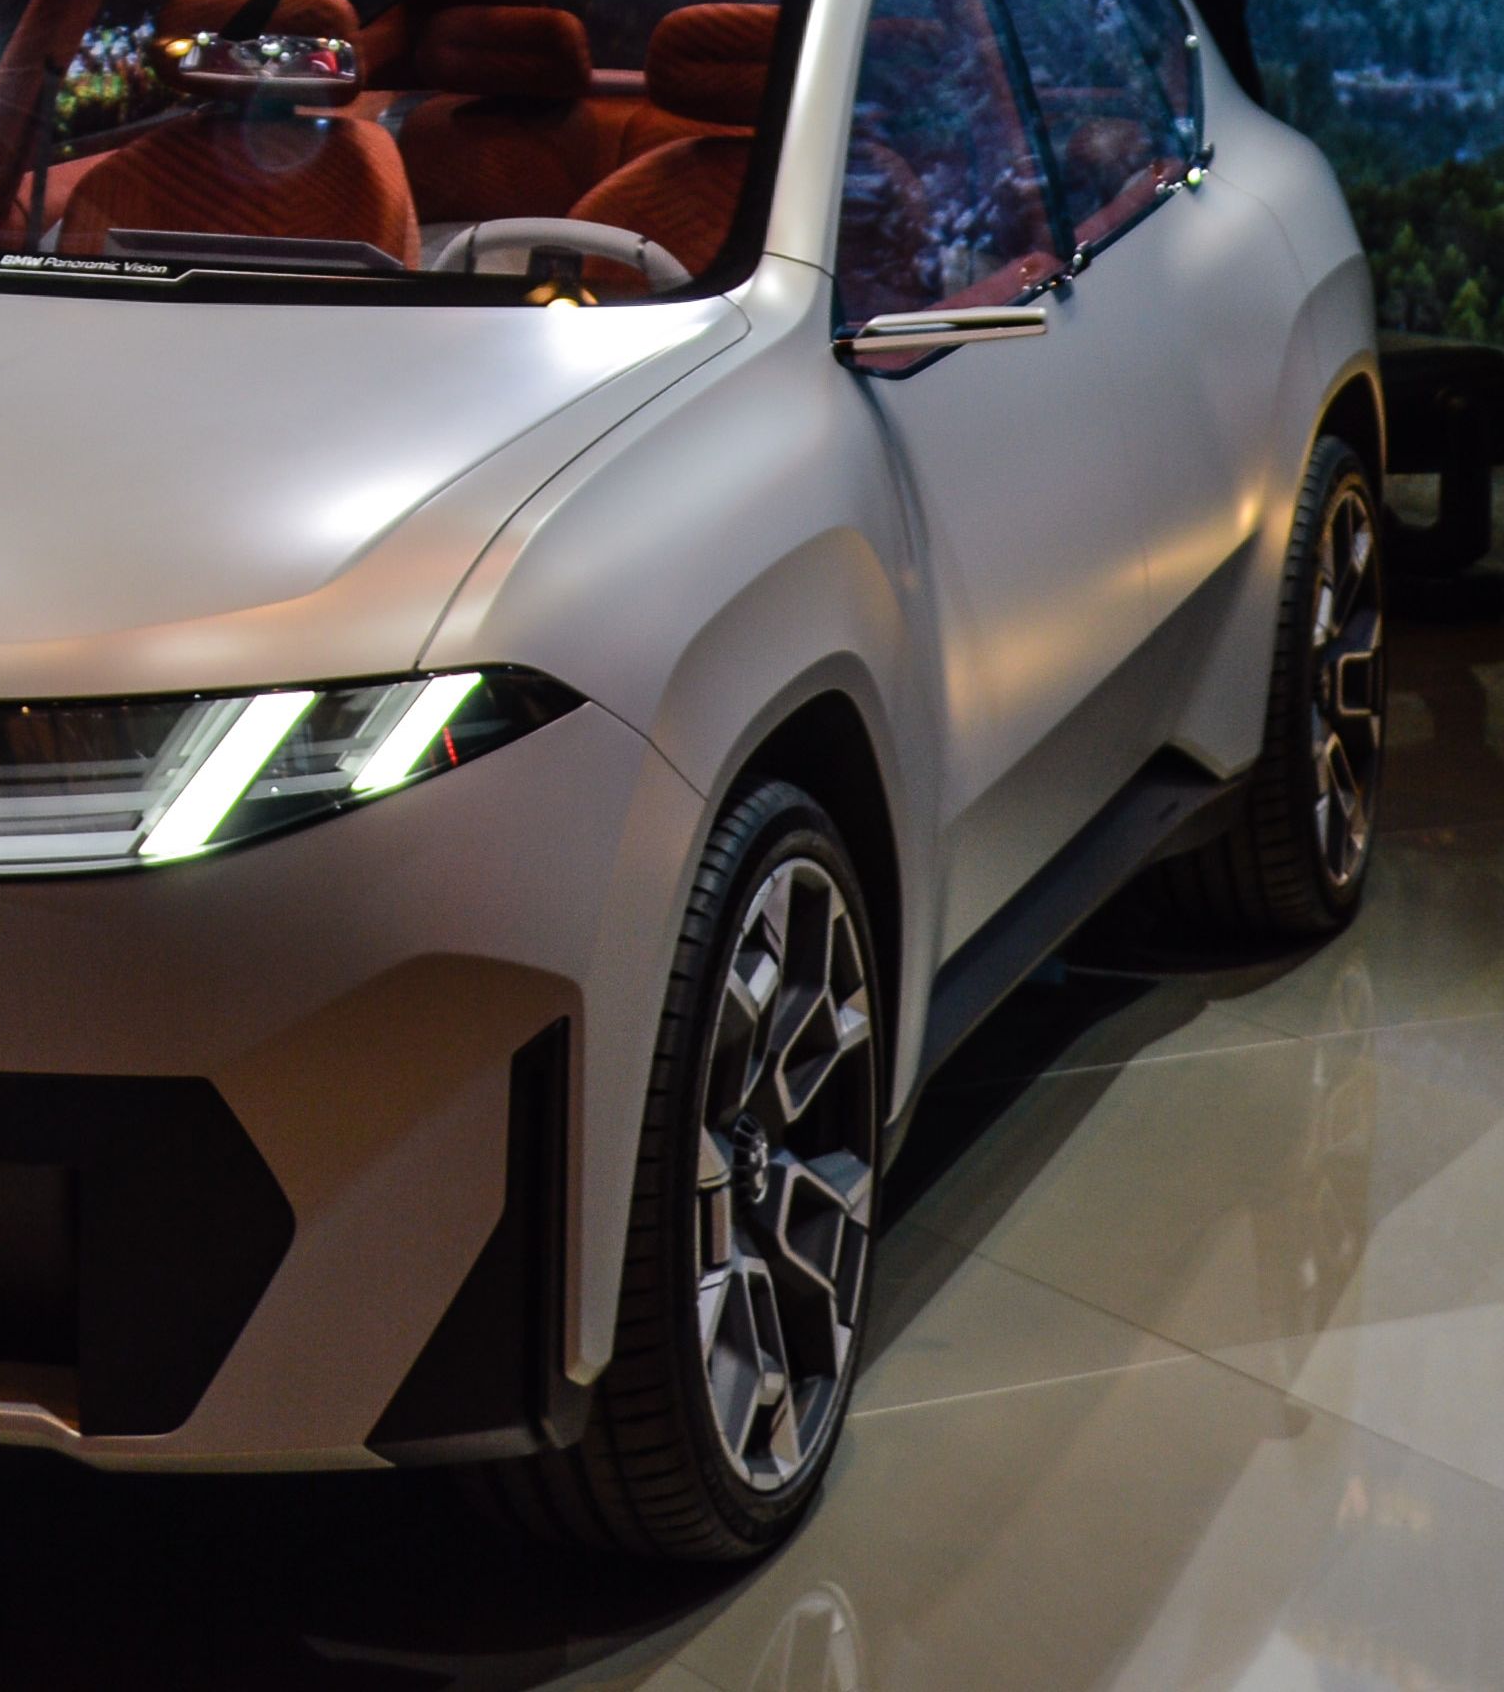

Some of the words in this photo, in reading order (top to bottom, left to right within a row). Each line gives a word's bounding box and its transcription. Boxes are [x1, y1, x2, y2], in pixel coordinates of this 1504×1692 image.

[0, 254, 43, 268] BMW
[43, 256, 120, 272] Panoramic
[123, 260, 169, 274] Vision
